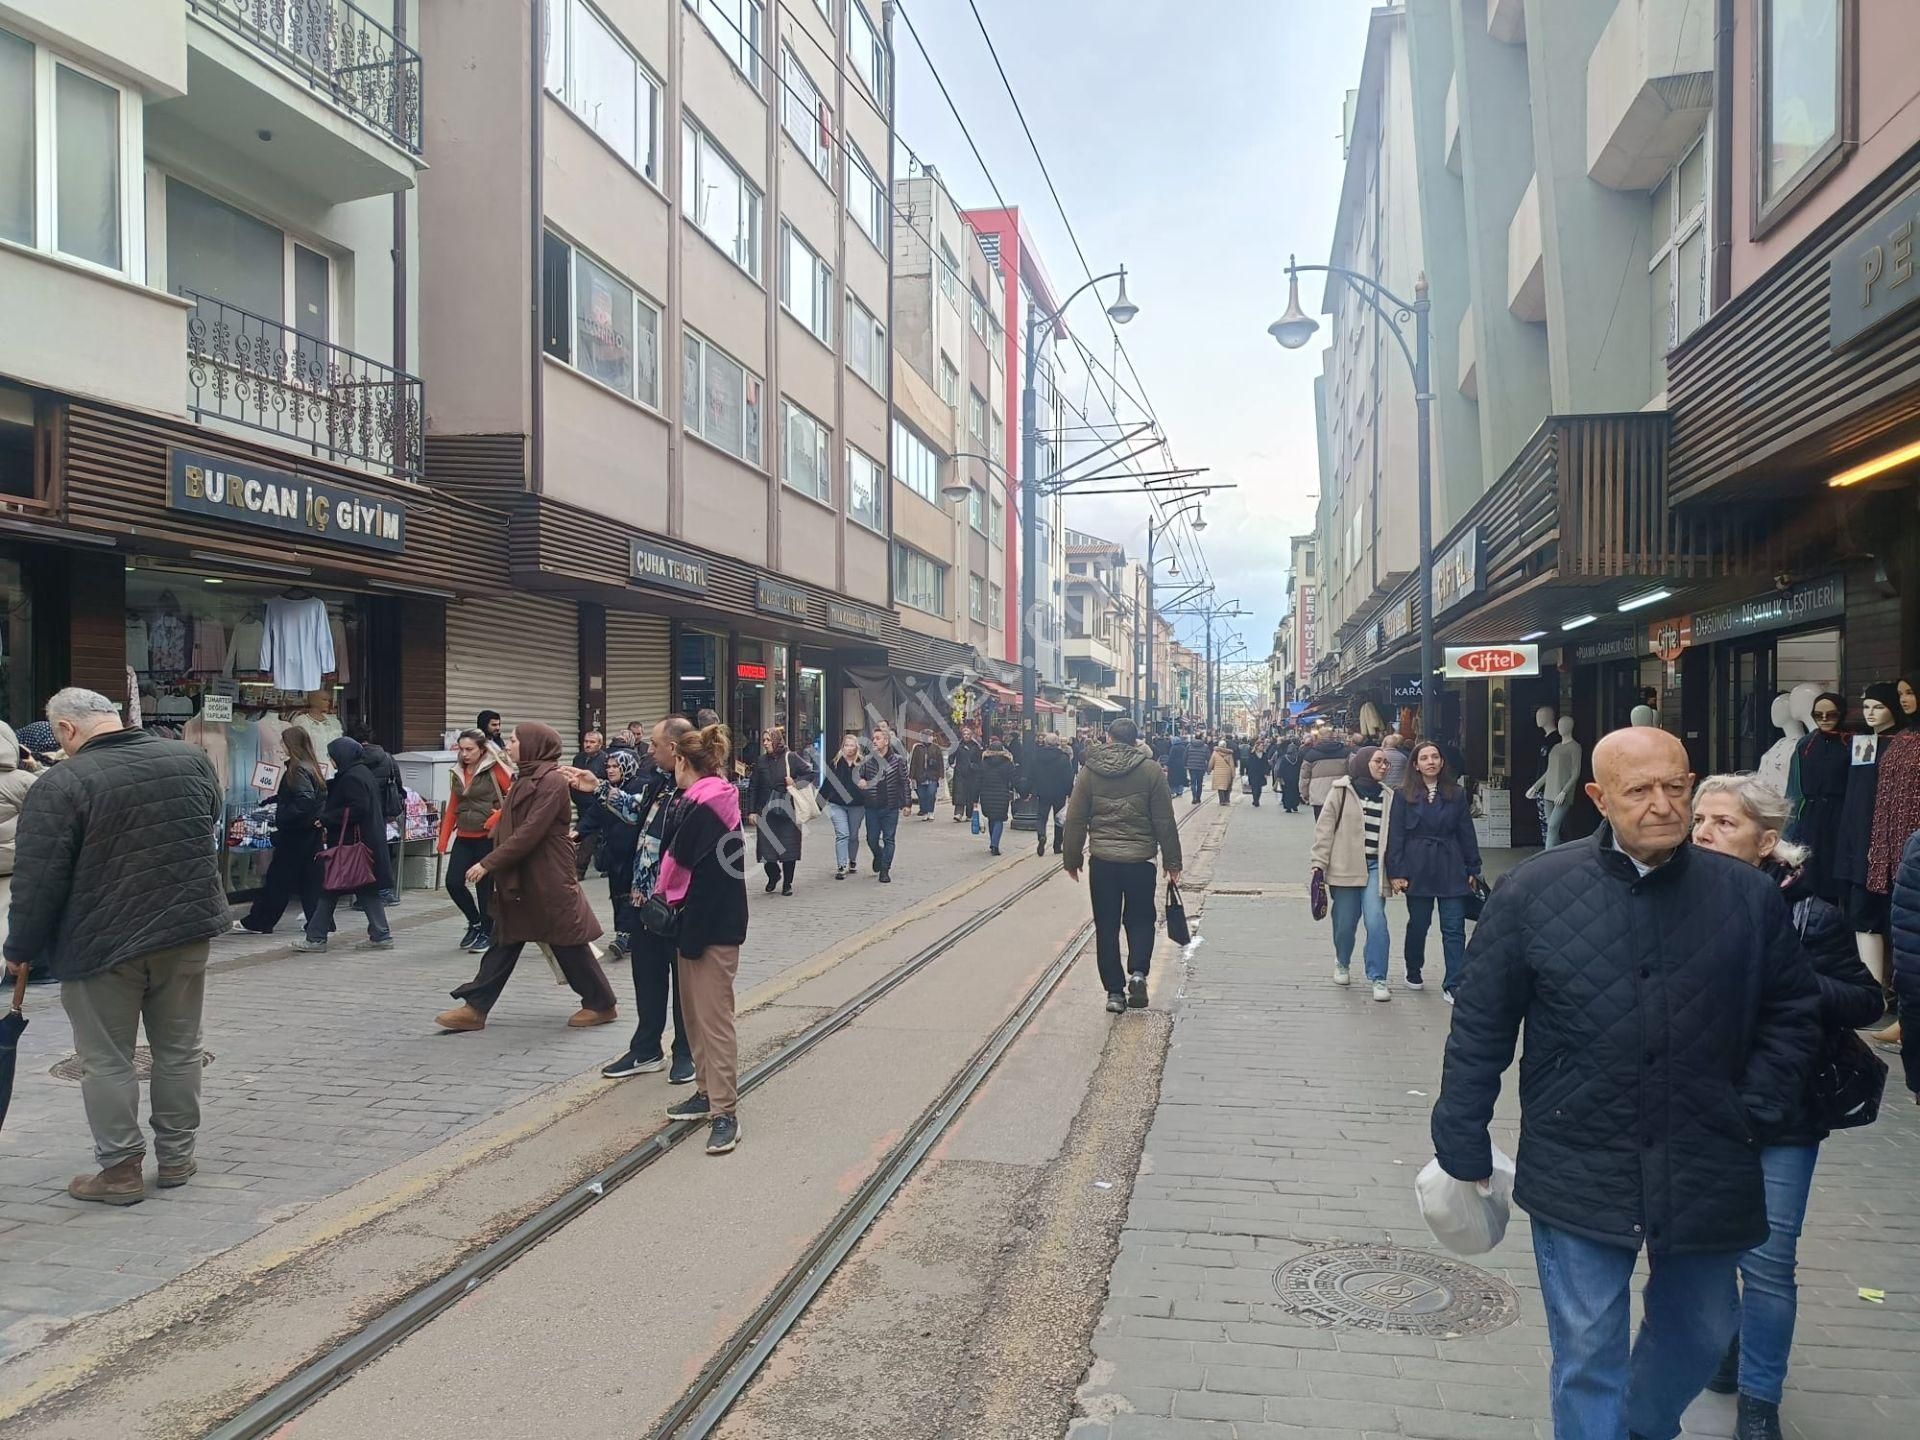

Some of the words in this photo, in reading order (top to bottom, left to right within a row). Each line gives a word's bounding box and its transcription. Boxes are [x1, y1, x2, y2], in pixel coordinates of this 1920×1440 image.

[185, 464, 298, 519] BURCAN
[305, 486, 330, 532] İÇ
[336, 498, 399, 540] GİYİM
[636, 550, 666, 575] ÇUHA
[667, 559, 707, 587] TEKSTİL
[1305, 587, 1315, 621] MERT
[1741, 599, 1783, 627] NİŞANLIK
[1787, 580, 1835, 620] ÇEŞİTLERİ
[1468, 651, 1515, 672] Çiftel
